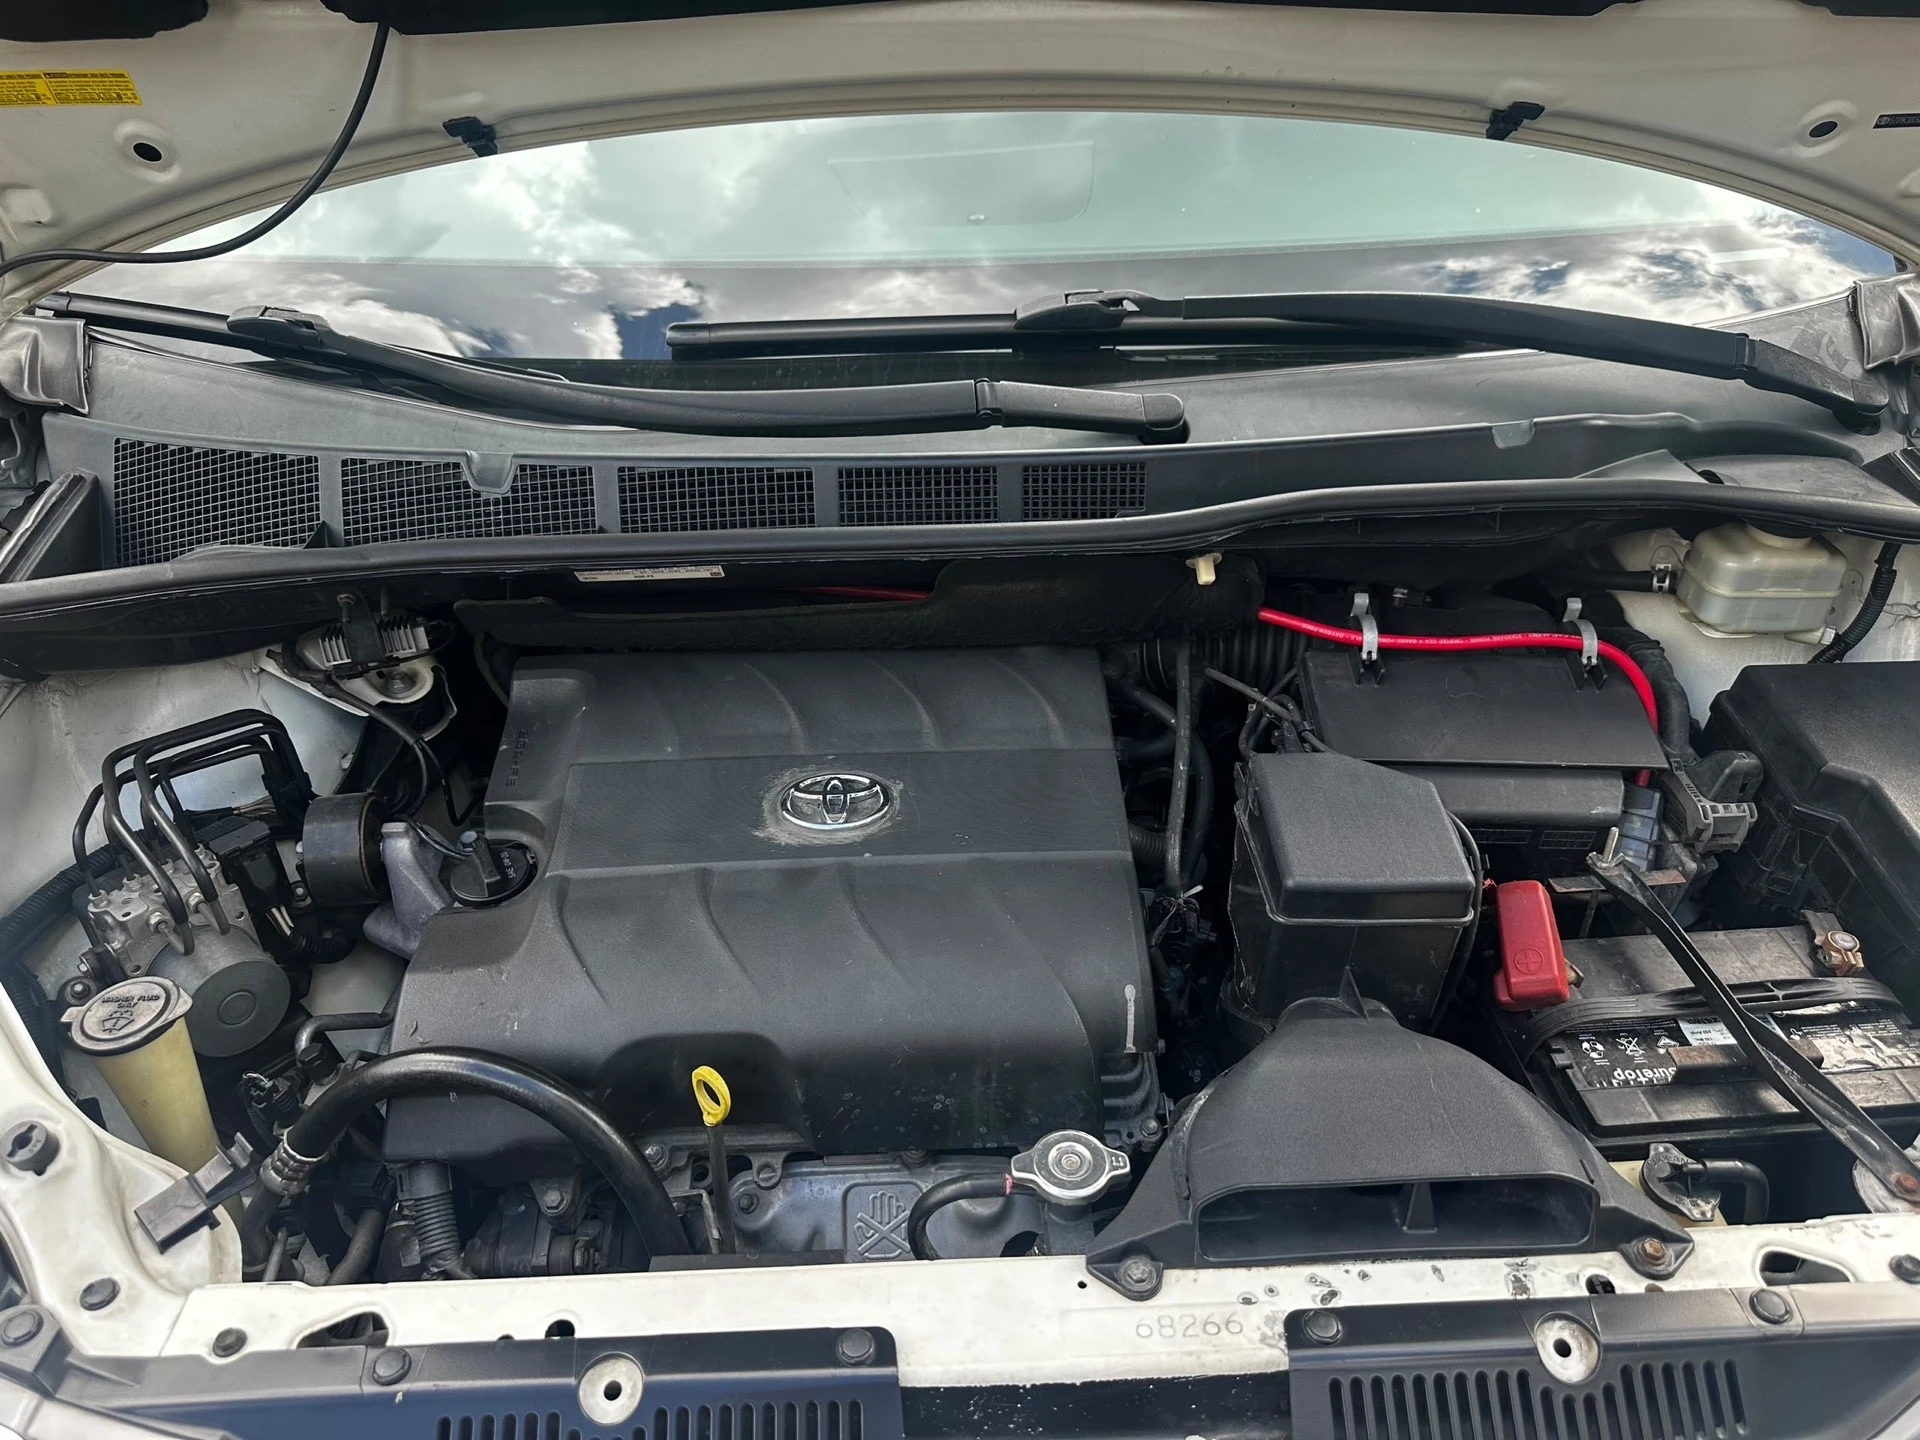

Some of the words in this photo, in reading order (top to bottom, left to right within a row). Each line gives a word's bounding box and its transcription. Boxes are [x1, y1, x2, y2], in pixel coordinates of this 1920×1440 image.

[101, 995, 135, 1003] WASHER
[137, 994, 160, 1002] FLUID
[117, 1001, 139, 1009] ONLY
[1135, 1310, 1244, 1339] 68266
